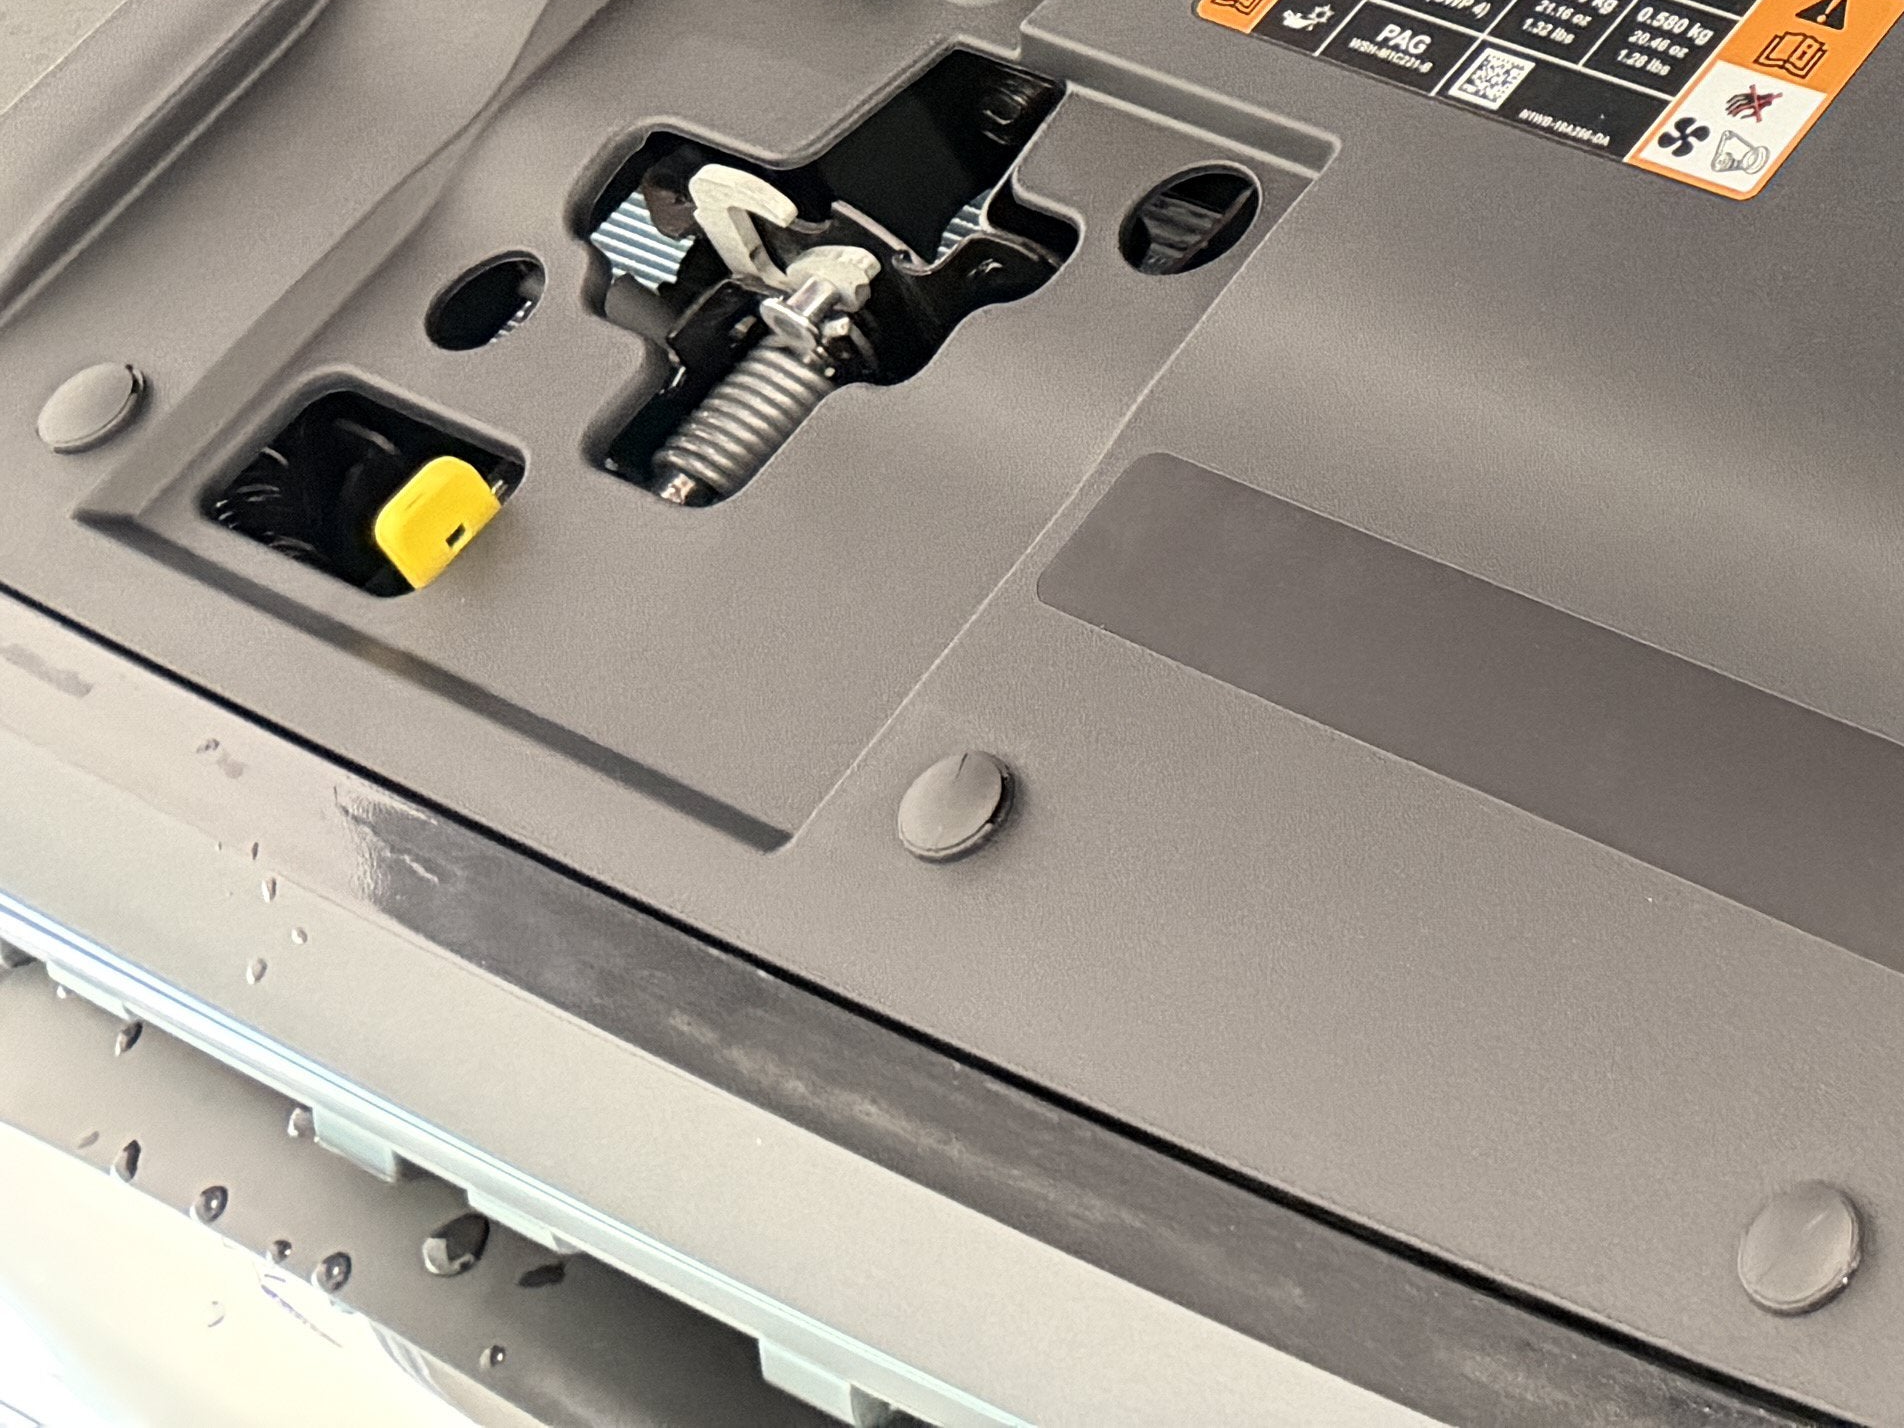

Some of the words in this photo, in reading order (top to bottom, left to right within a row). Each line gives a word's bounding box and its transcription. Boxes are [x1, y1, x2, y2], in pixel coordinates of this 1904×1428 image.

[1471, 1, 1492, 19] 4)
[1535, 0, 1574, 21] 21.16
[1572, 12, 1593, 28] oz
[1375, 24, 1432, 55] PAG
[1522, 18, 1554, 37] 1.32
[1551, 26, 1576, 44] lbs
[1636, 6, 1689, 34] 0.580
[1686, 22, 1714, 46] kg
[1616, 49, 1649, 69] 1.28
[1646, 58, 1672, 76] lbs
[1668, 44, 1690, 59] oz
